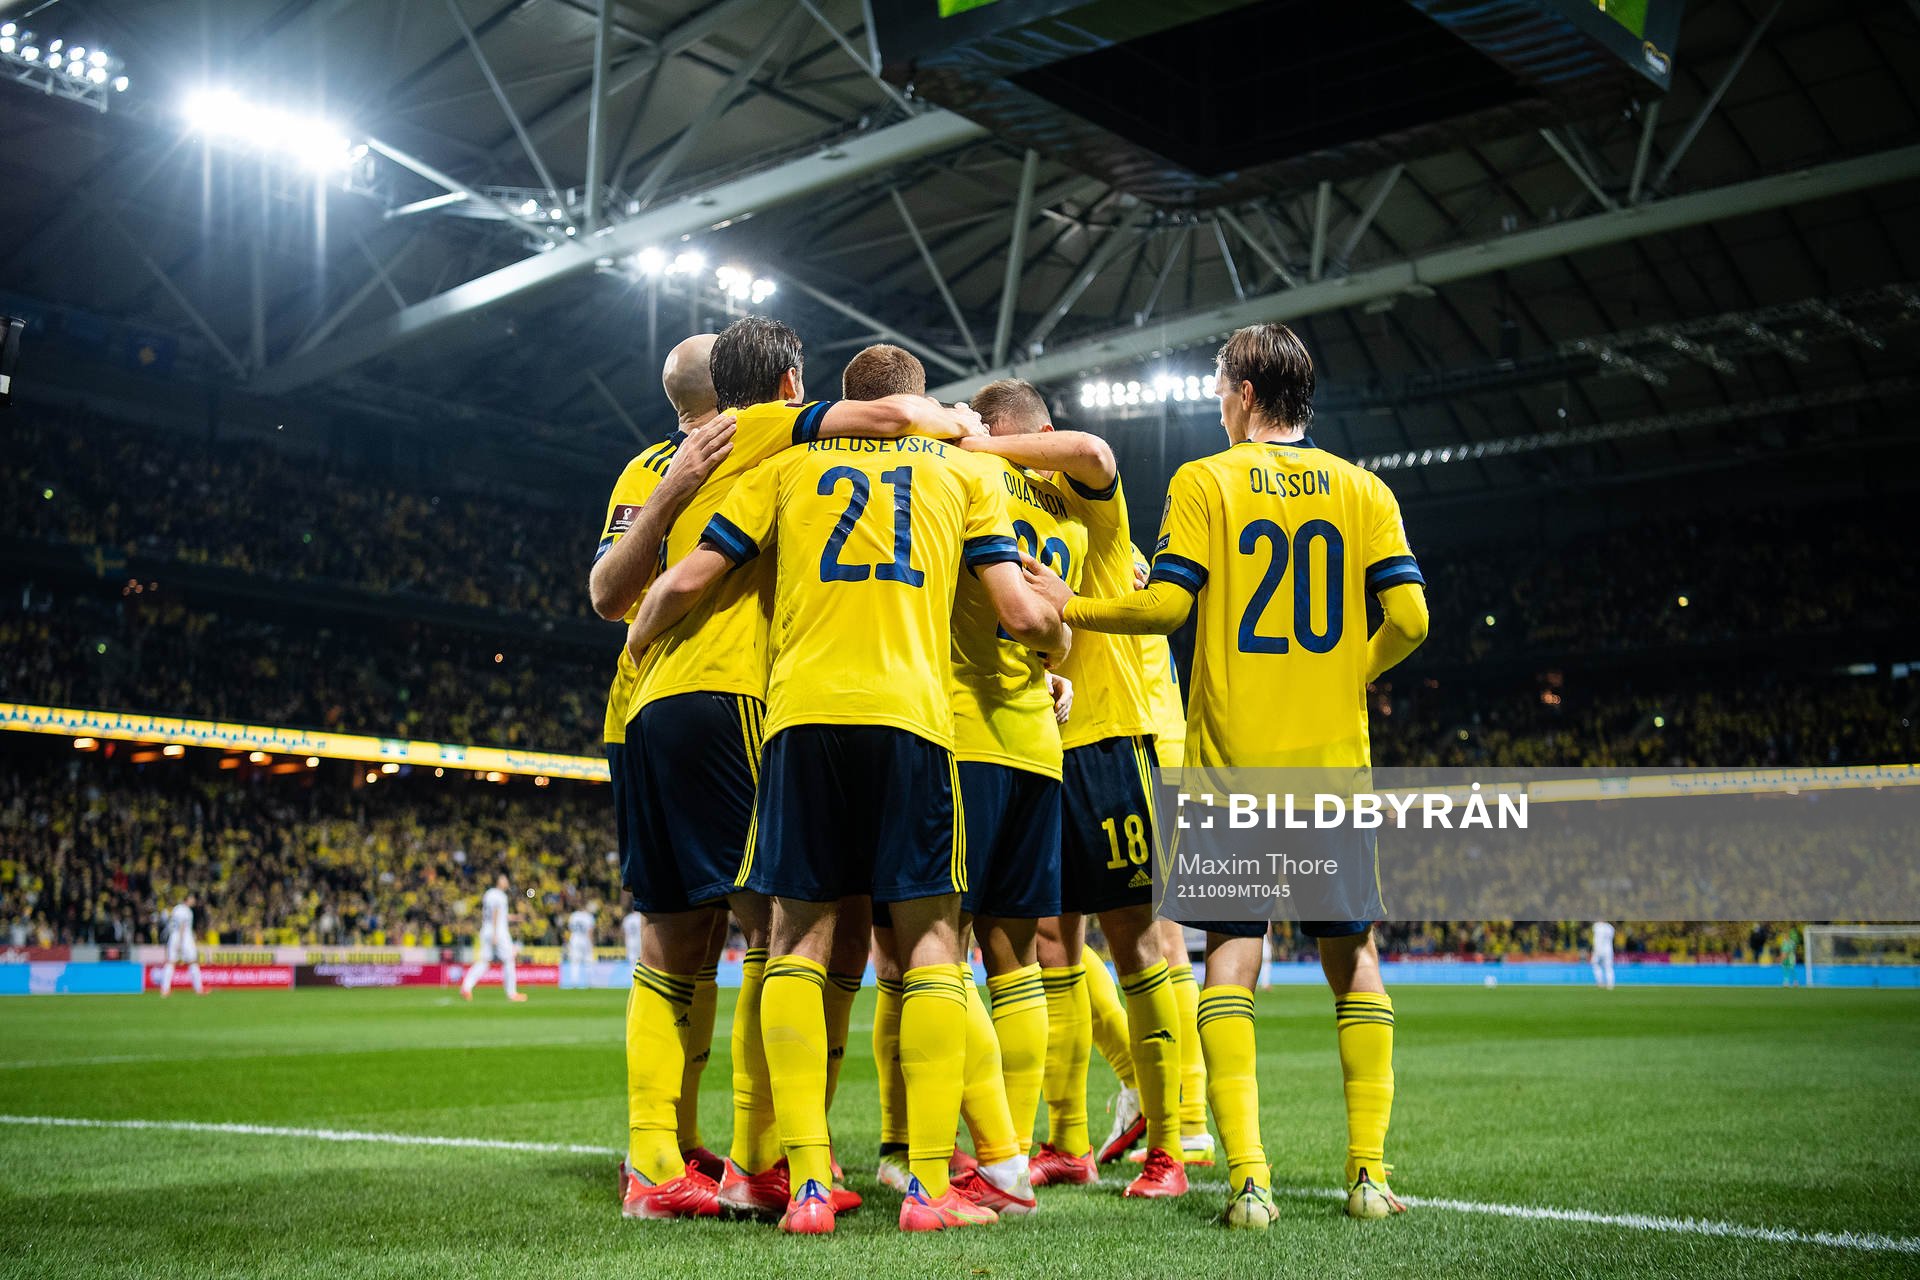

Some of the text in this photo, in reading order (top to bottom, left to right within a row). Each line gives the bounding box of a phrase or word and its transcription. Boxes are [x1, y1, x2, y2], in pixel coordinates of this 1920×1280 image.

[808, 437, 948, 459] KULUSEVSKI
[1003, 471, 1068, 519] QUAISON
[1249, 467, 1330, 498] OLSSON
[816, 465, 925, 588] 21
[1237, 518, 1344, 654] 20
[1101, 814, 1149, 870] 18
